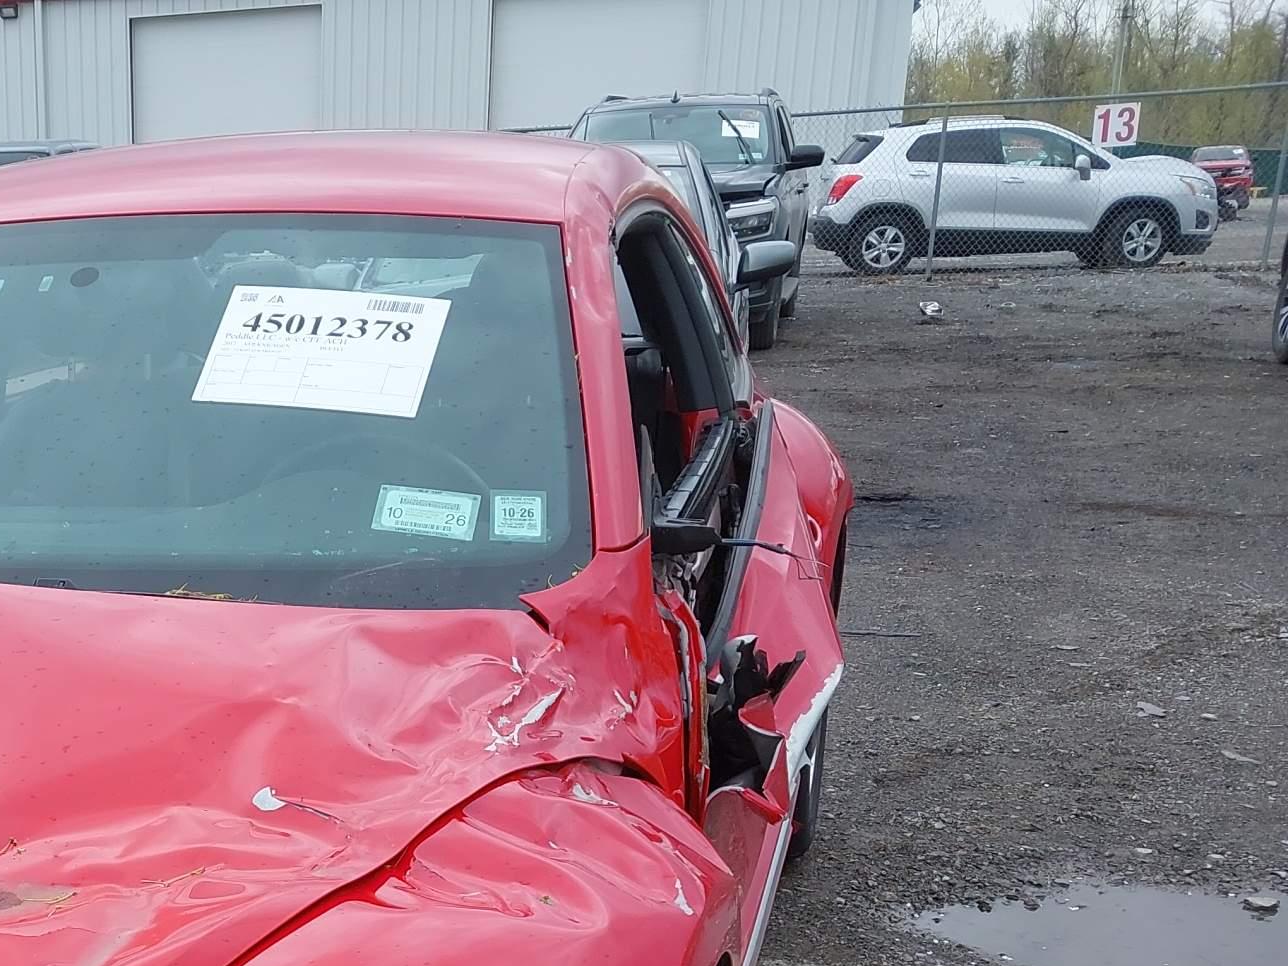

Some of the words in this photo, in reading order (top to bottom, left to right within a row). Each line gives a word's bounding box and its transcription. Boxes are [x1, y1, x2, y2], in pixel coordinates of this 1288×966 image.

[1098, 107, 1136, 143] 13
[242, 311, 414, 343] 45012378
[386, 506, 403, 519] 10
[501, 507, 535, 518] 10-26
[445, 513, 466, 527] 26
